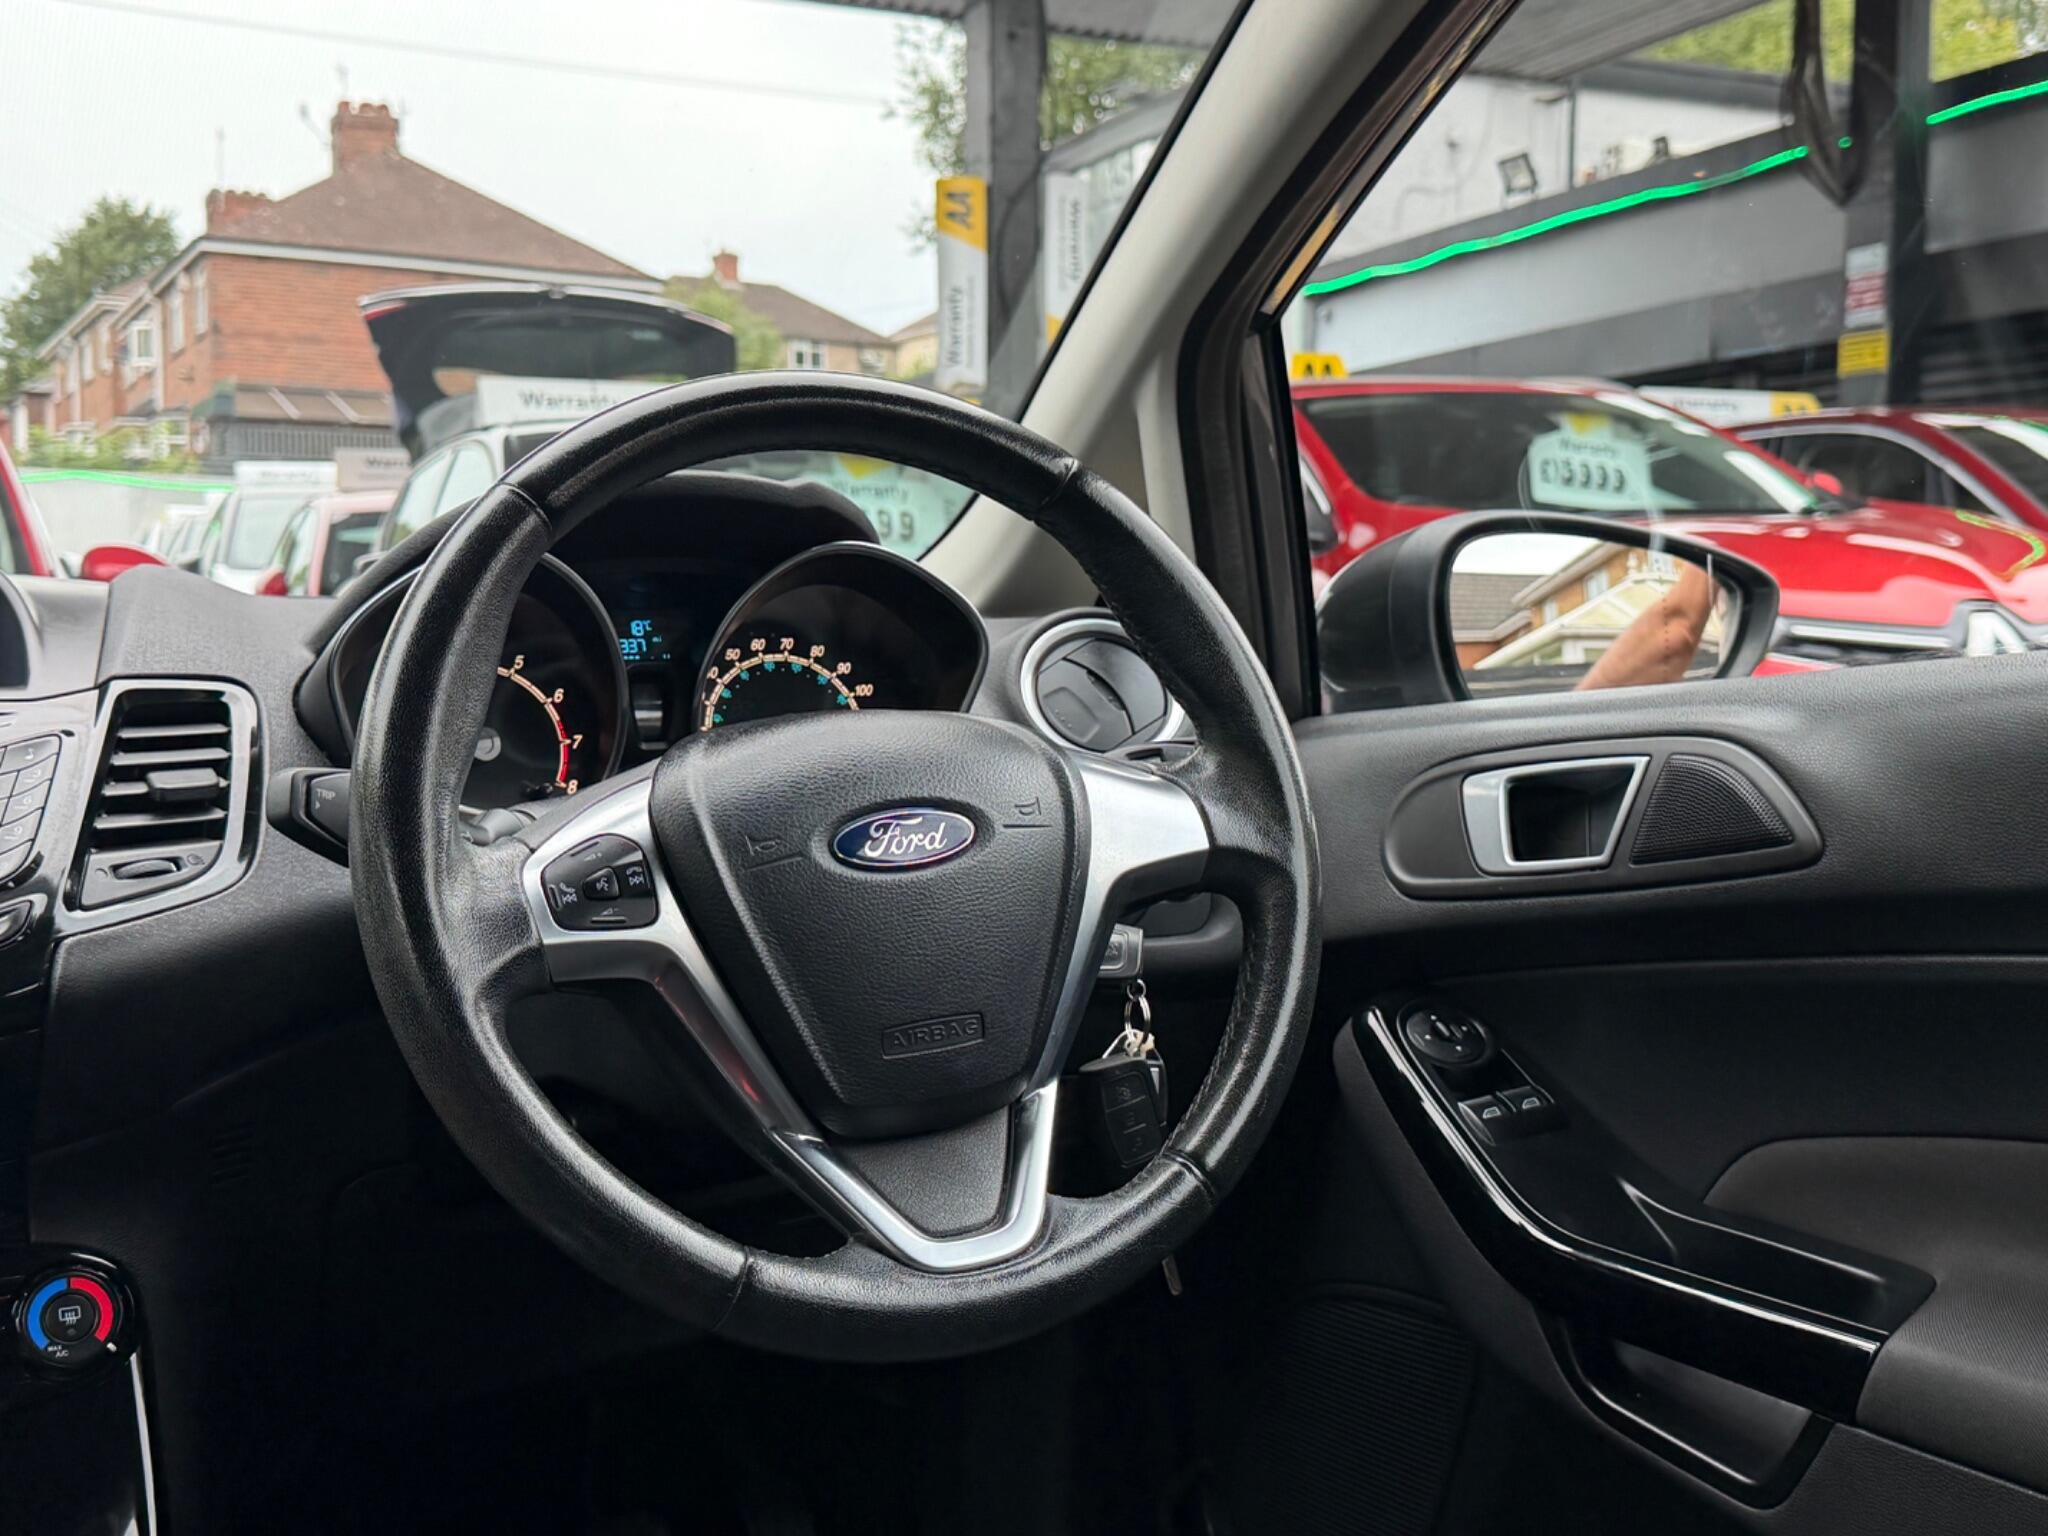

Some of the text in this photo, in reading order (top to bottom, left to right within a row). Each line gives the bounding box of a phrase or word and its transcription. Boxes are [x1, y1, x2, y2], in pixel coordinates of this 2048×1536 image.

[751, 639, 766, 651] 60
[780, 638, 794, 650] 70
[725, 649, 740, 660] 50
[810, 645, 825, 657] 80
[514, 655, 525, 669] 5
[837, 662, 851, 674] 90
[554, 688, 565, 703] 6
[855, 684, 874, 696] 100
[572, 734, 583, 749] 7
[567, 780, 578, 794] 8
[316, 788, 336, 800] TRIP
[864, 816, 948, 857] Ford
[893, 1019, 979, 1046] AIRBAG
